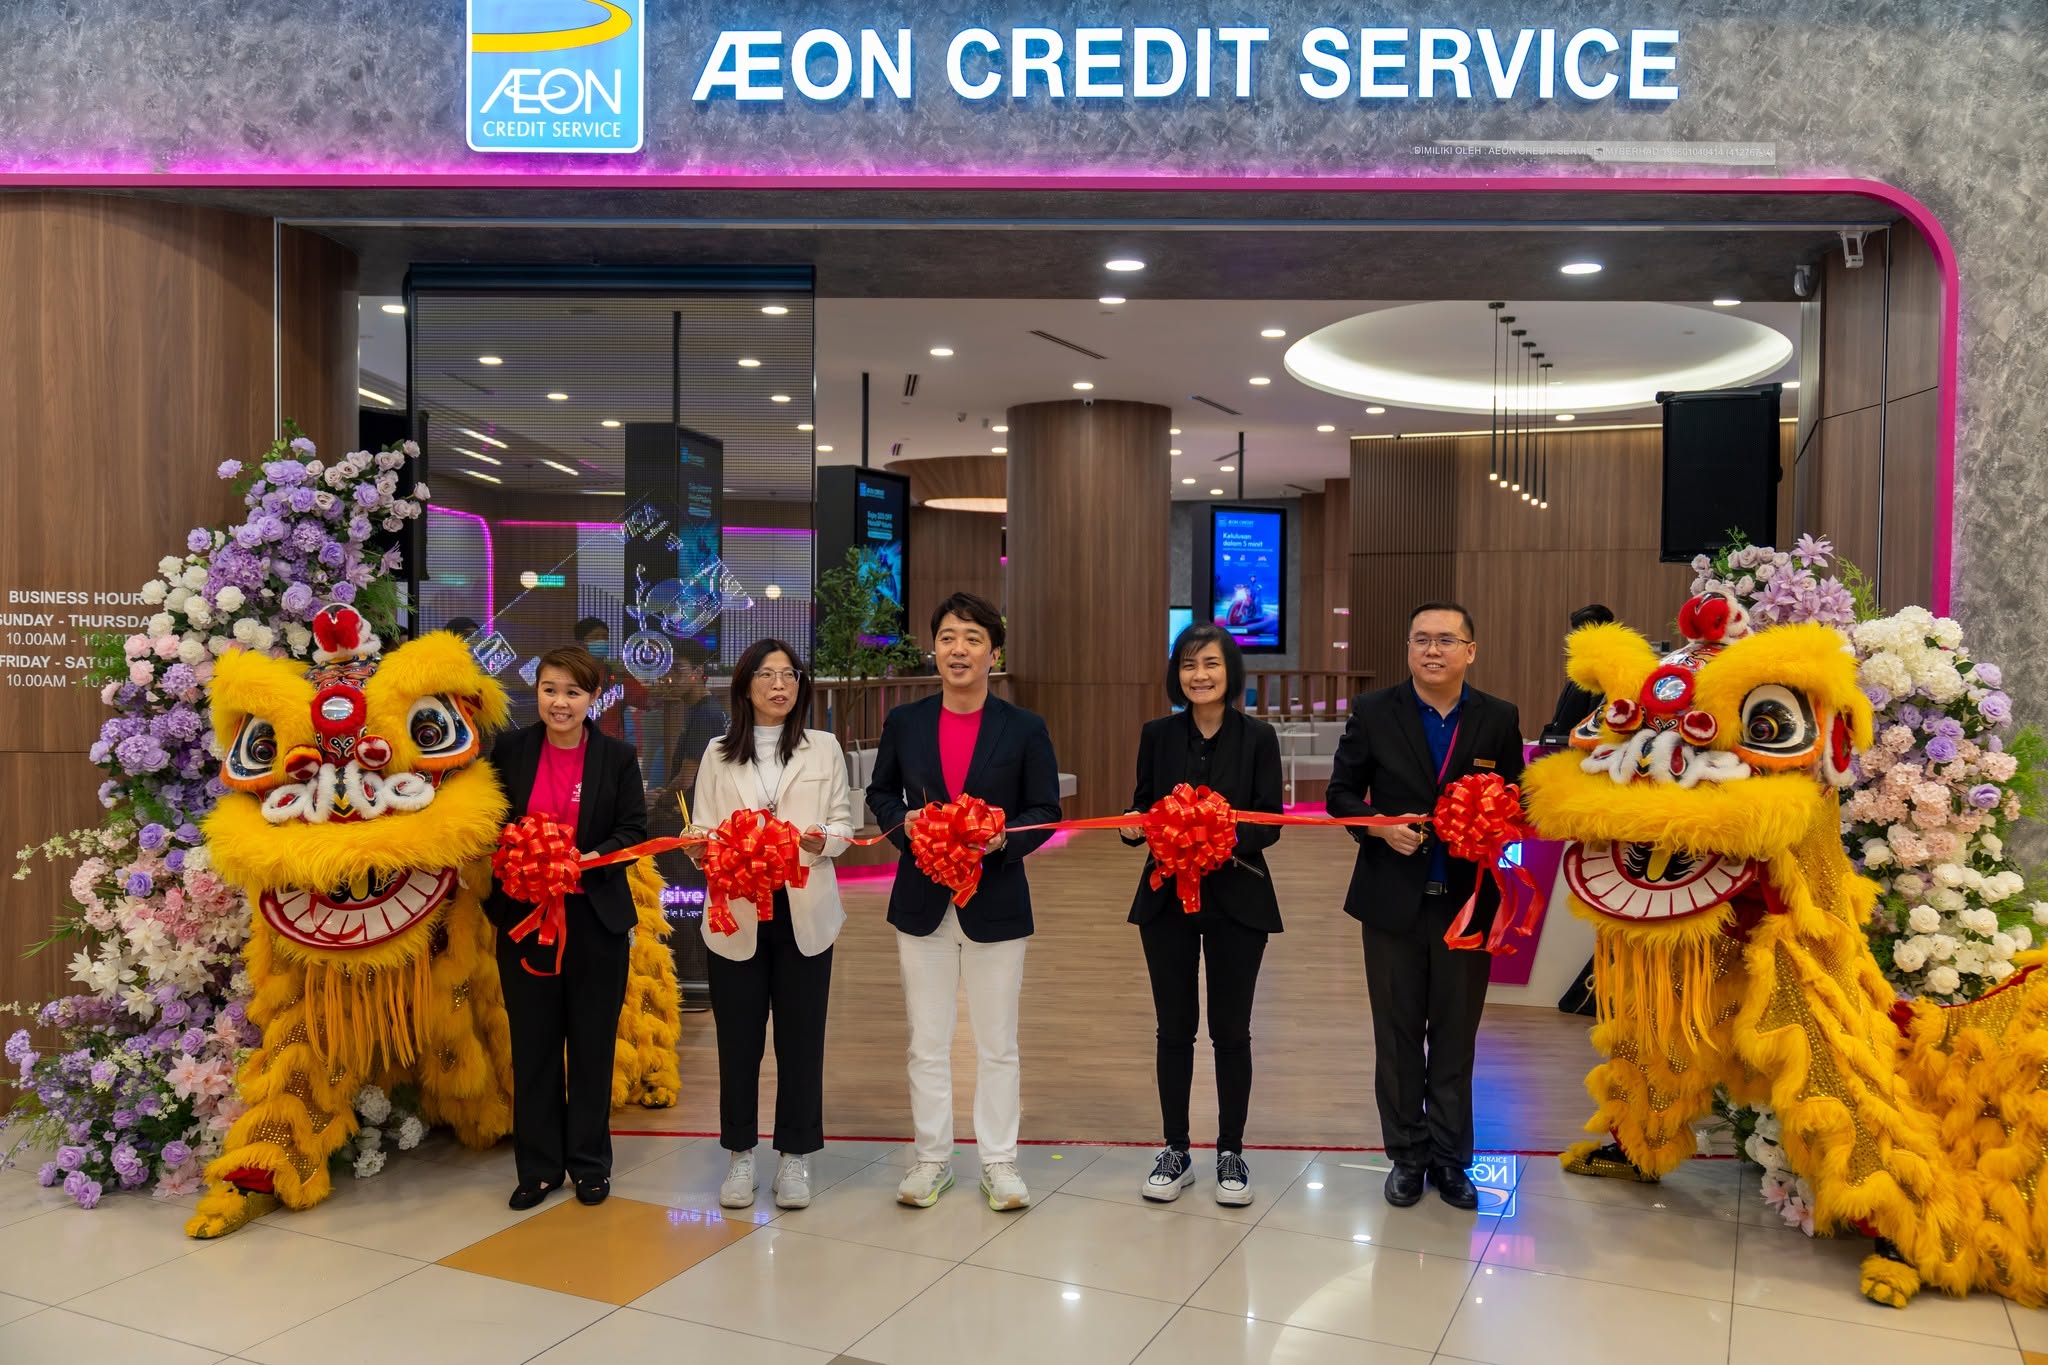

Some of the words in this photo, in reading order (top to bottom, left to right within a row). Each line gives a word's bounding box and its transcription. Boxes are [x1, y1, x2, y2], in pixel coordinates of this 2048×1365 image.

[946, 27, 1270, 100] CREDIT
[1299, 27, 1680, 101] SERVICE
[483, 121, 547, 137] CREDIT
[552, 121, 621, 138] SERVICE
[1414, 146, 1453, 155] DIMILIKI
[1455, 146, 1482, 155] OLEH
[1488, 146, 1517, 156] AEON
[1518, 146, 1554, 156] CREDIT
[1619, 147, 1658, 157] BERHAD
[9, 590, 89, 605] BUSINESS
[94, 592, 145, 606] HOUR
[68, 614, 150, 627] THURSDA
[6, 632, 66, 646] 10.00AM
[0, 655, 51, 668] FRIDAY
[65, 656, 114, 669] SATU
[6, 674, 66, 687] 10.00AM
[660, 885, 705, 905] sive
